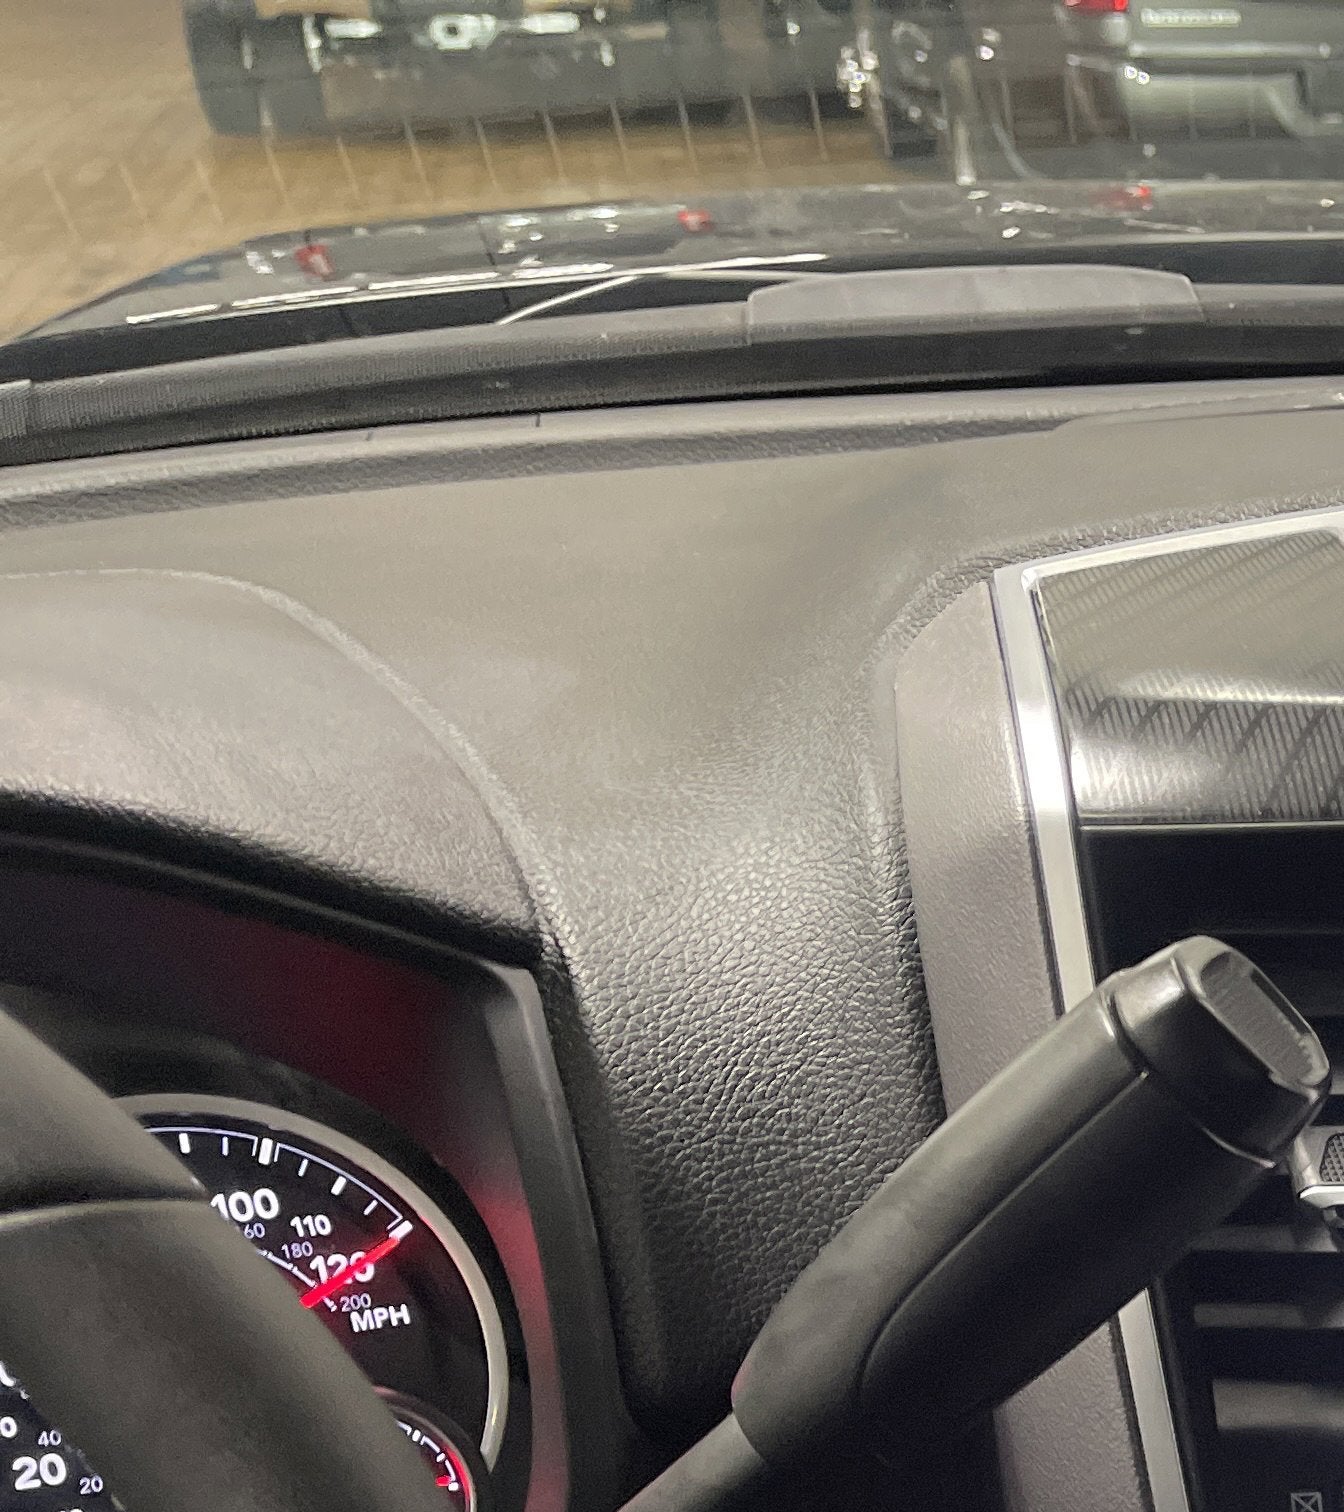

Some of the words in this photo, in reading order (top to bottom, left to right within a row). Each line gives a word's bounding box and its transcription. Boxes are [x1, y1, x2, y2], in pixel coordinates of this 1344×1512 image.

[210, 1188, 280, 1223] 100
[243, 1222, 266, 1240] 60
[290, 1214, 333, 1238] 110
[281, 1241, 314, 1259] 180
[309, 1251, 376, 1285] 120
[340, 1293, 372, 1313] 200
[350, 1303, 412, 1333] MPH
[38, 1429, 62, 1447] 40
[12, 1452, 68, 1491] 20
[79, 1475, 104, 1495] 20
